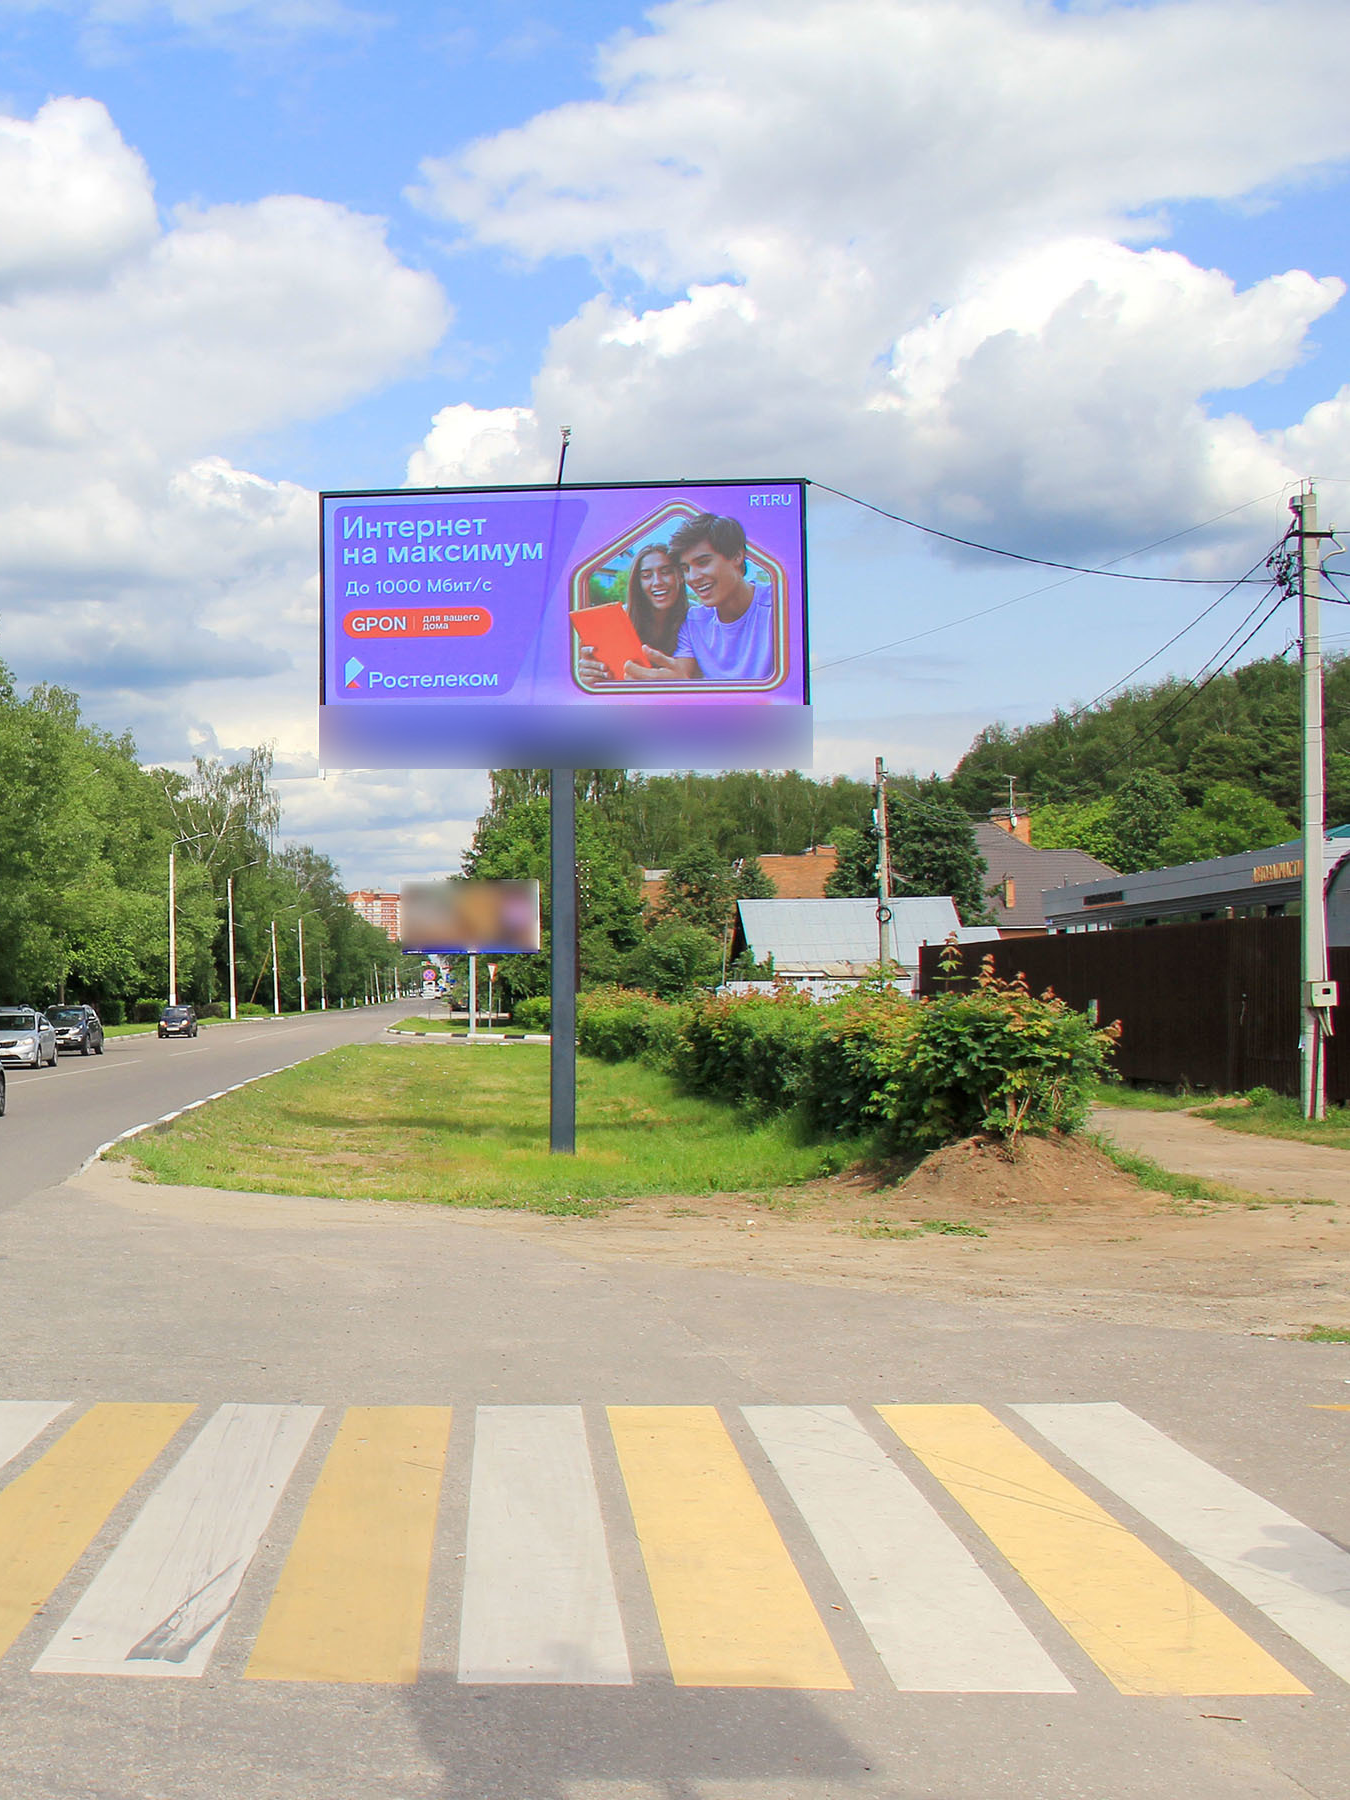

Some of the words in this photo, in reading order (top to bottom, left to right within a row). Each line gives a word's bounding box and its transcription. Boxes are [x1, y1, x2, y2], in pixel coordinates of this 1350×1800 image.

[749, 494, 792, 506] RT.RU
[343, 516, 487, 544] Интернет
[343, 546, 377, 565] на
[387, 542, 544, 567] максимум
[345, 580, 370, 597] До
[375, 579, 421, 594] 1000
[427, 576, 493, 594] Мбит/с
[351, 616, 407, 632] GPON
[422, 615, 441, 624] для
[443, 613, 481, 623] вашего
[422, 623, 449, 632] дома
[368, 671, 499, 689] Ростелеком
